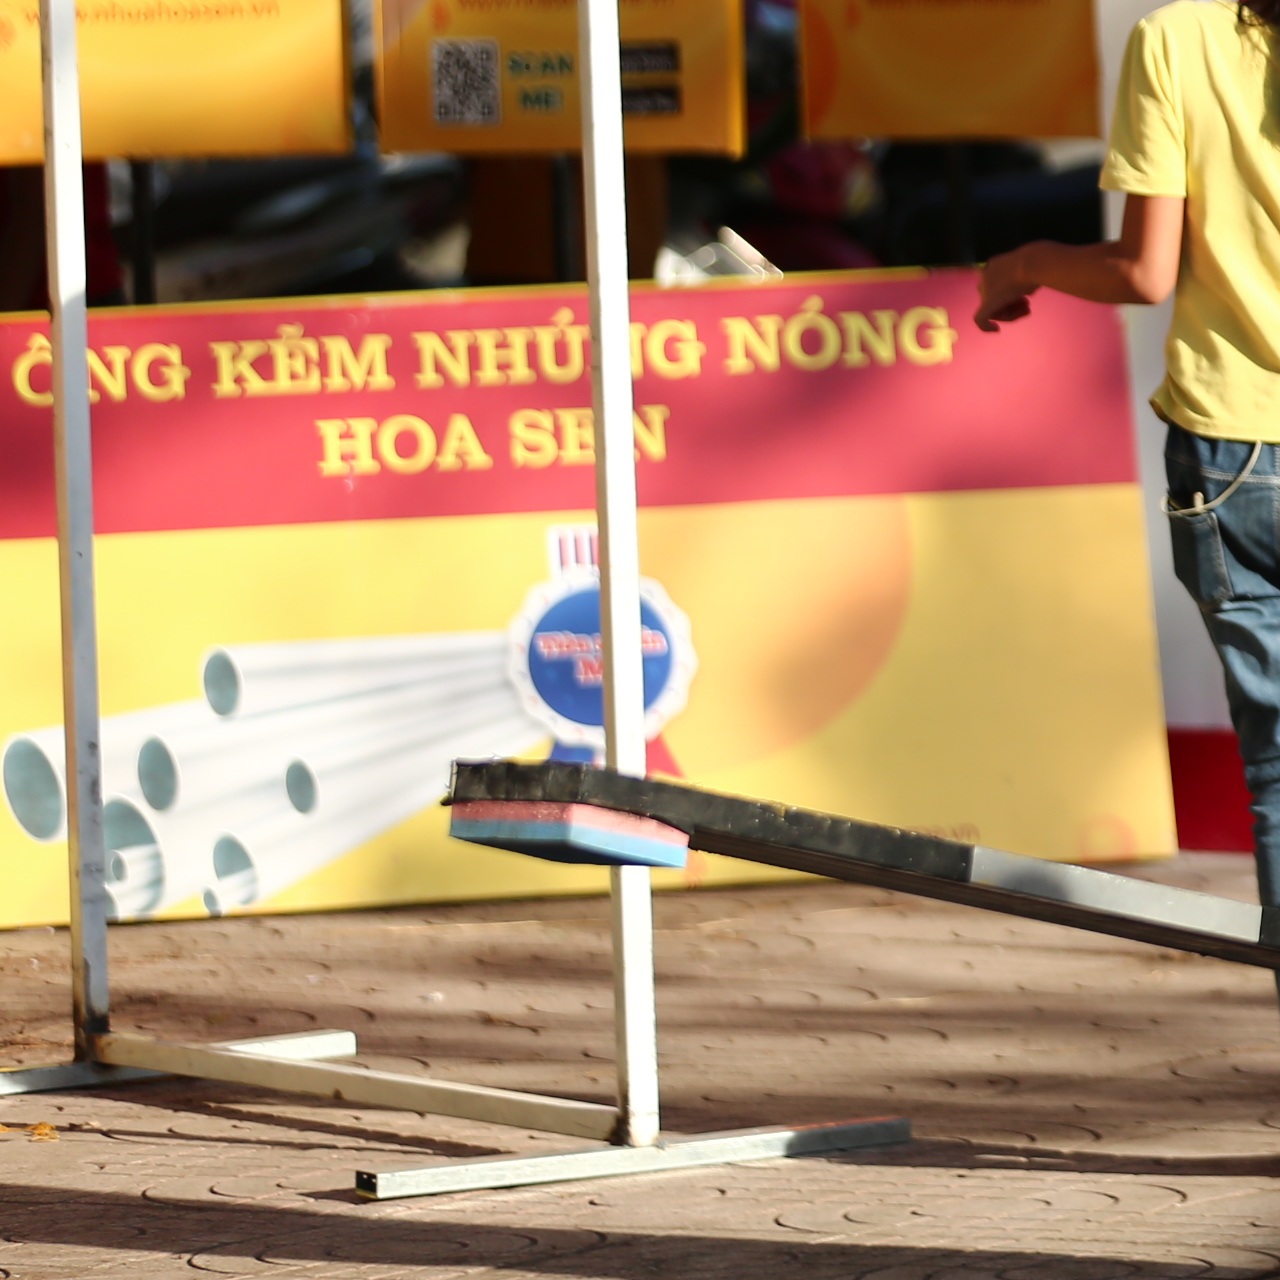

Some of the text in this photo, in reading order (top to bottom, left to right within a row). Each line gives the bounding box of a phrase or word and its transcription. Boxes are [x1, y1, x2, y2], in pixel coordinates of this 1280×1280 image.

[508, 50, 575, 80] SCAN
[208, 321, 396, 400] KẼM
[721, 294, 957, 376] NÓNG
[314, 413, 494, 477] HOA
